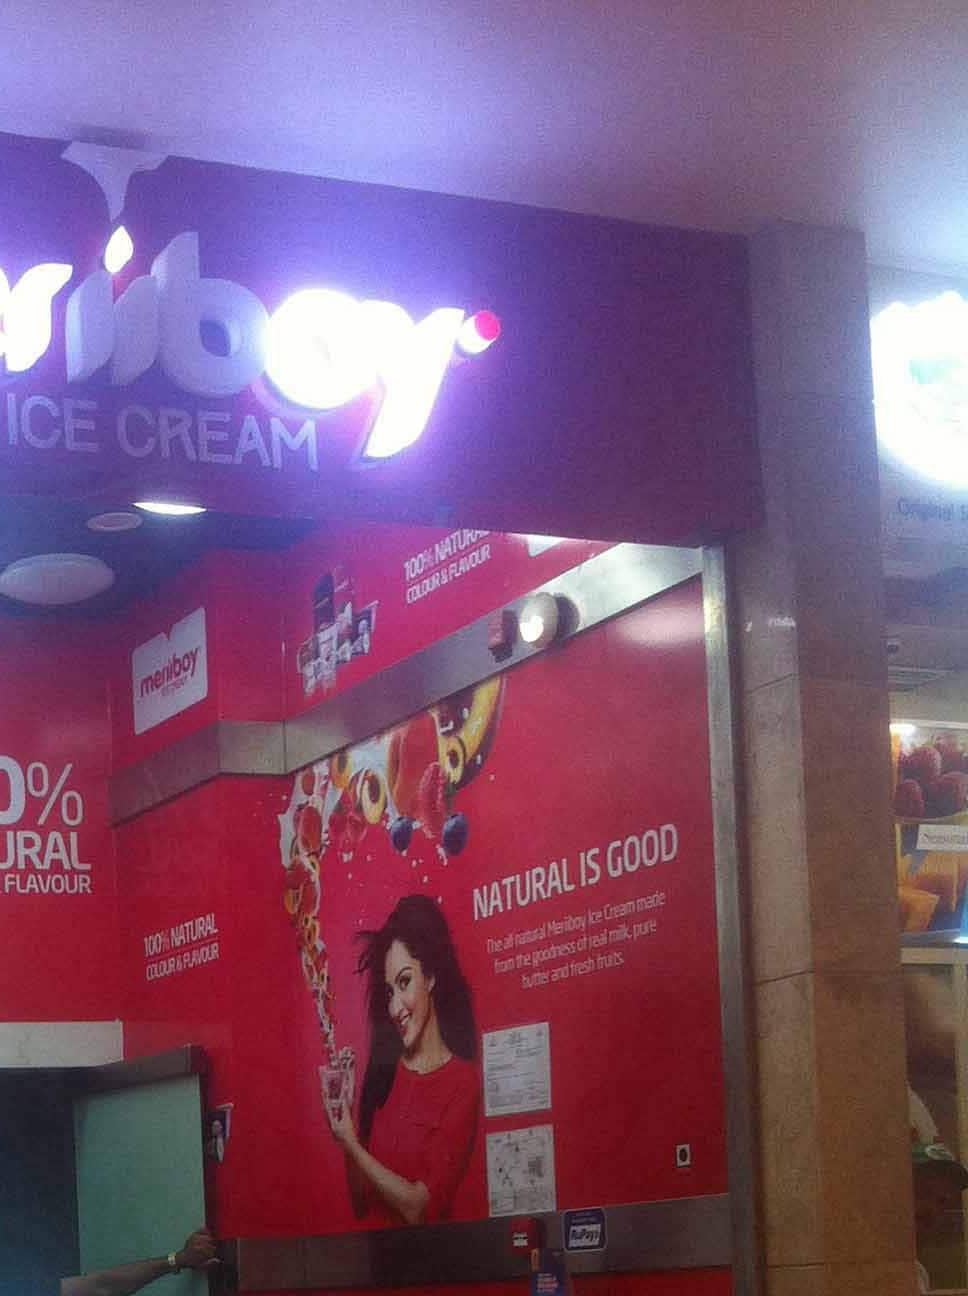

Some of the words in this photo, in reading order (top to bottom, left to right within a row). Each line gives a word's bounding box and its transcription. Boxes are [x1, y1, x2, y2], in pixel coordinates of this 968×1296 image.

[6, 391, 100, 453] ICE
[117, 404, 319, 472] CREAM
[406, 574, 441, 605] COLOUR
[448, 543, 492, 580] FLAVOUR
[4, 874, 92, 894] FLAVOUR
[472, 858, 576, 921] NATURAL
[580, 847, 601, 887] IS
[606, 823, 678, 878] GOOD
[170, 911, 219, 948] NATURAL
[487, 938, 503, 955] The
[503, 933, 514, 950] all
[515, 926, 546, 948] natural
[588, 909, 603, 925] Ice
[603, 899, 635, 921] Cream
[636, 890, 666, 911] made
[494, 954, 514, 973] from
[516, 950, 532, 968] the
[532, 939, 575, 967] goodness
[576, 934, 588, 952] of
[589, 928, 608, 948] real
[633, 919, 657, 944] pure
[550, 964, 569, 982] and
[570, 956, 596, 978] fresh
